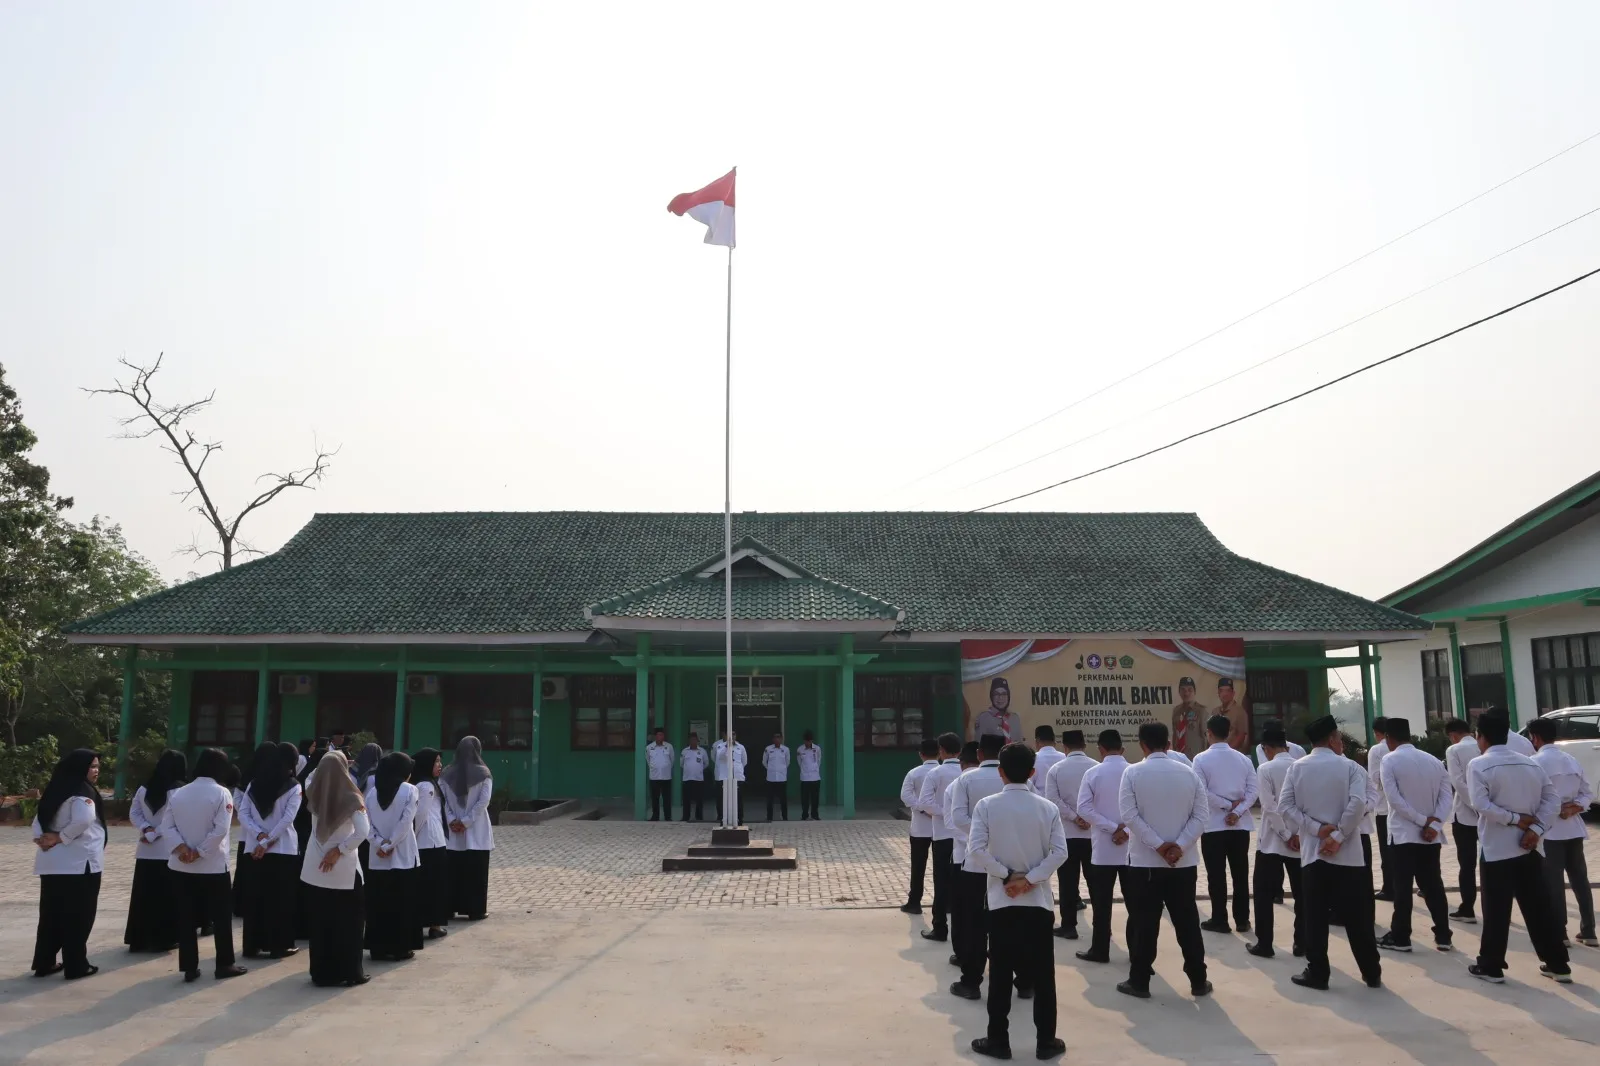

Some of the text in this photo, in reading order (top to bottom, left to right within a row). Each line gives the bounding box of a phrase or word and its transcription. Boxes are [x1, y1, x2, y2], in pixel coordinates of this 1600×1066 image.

[1031, 686, 1173, 706] KARYA AMAL BAKTI
[1061, 709, 1152, 717] KEMENTERIAN AGAMA
[1055, 718, 1105, 726] KABUPATEN
